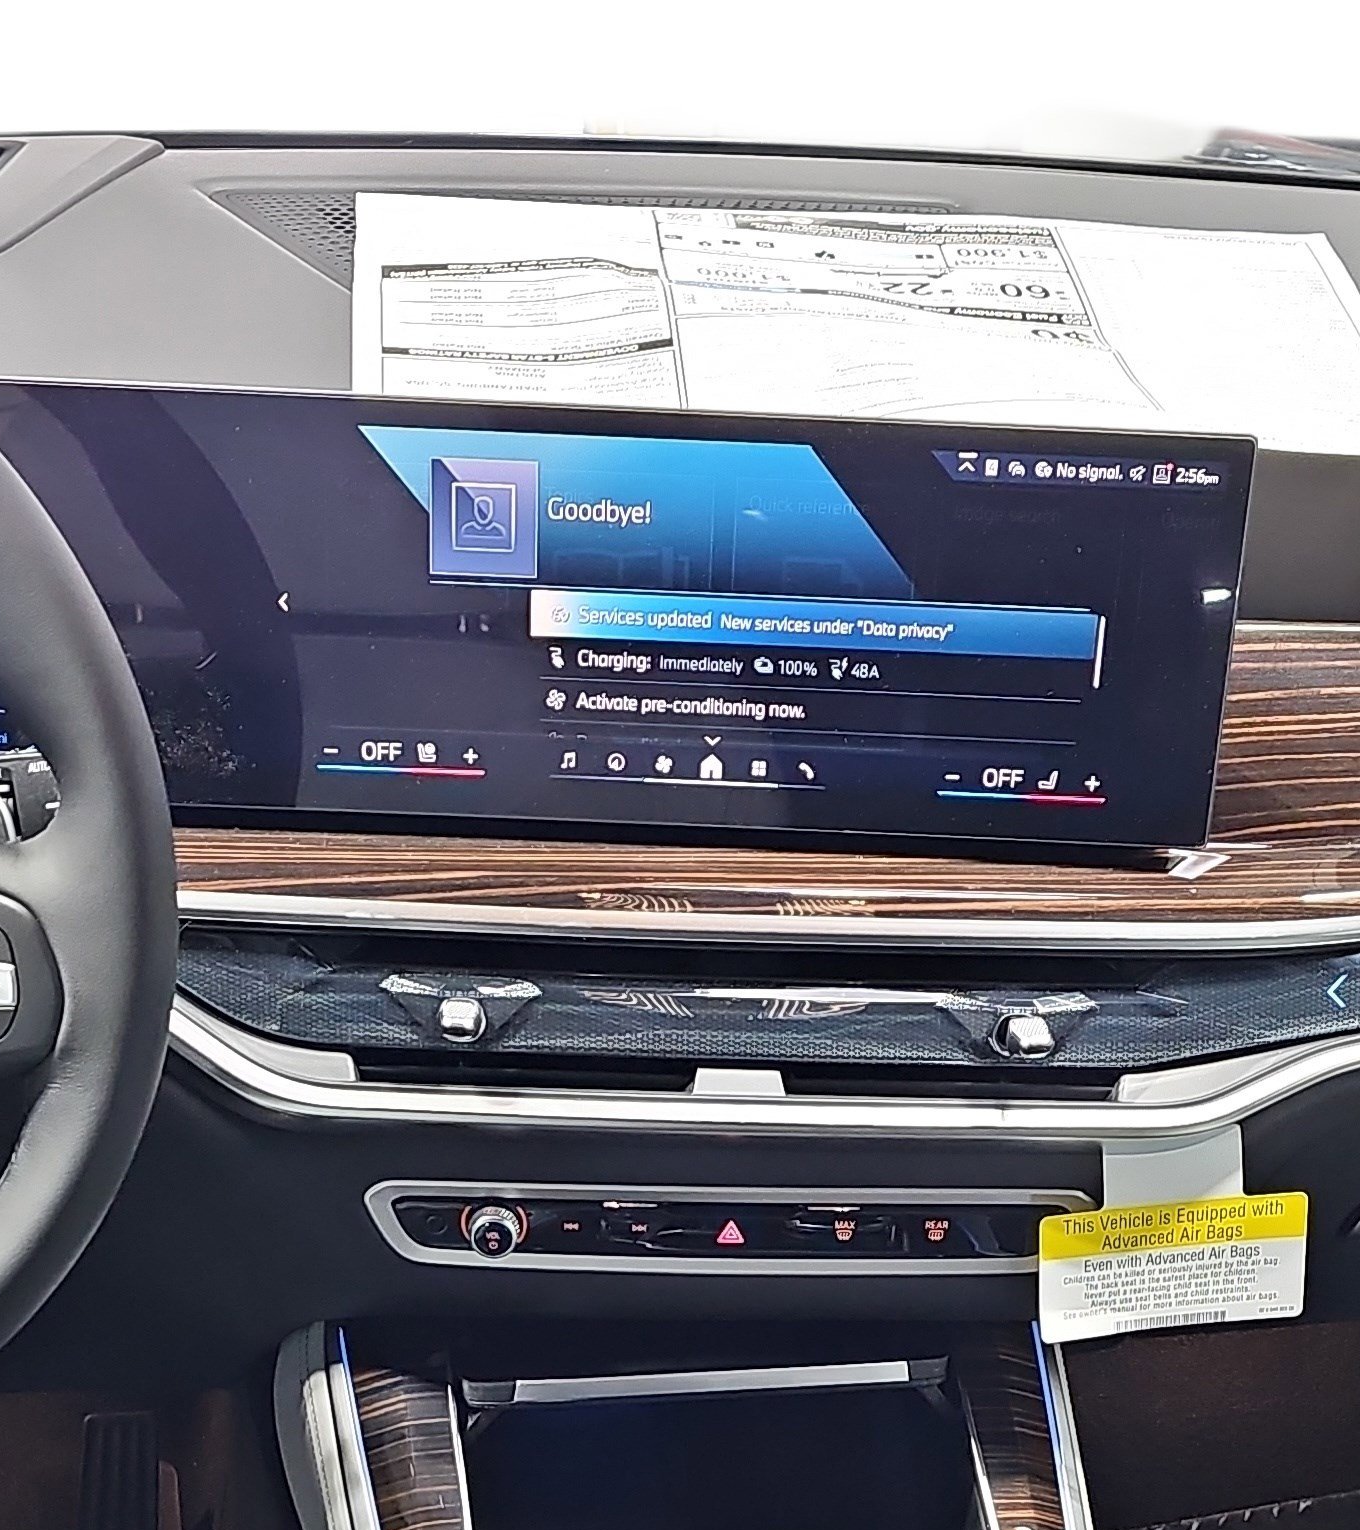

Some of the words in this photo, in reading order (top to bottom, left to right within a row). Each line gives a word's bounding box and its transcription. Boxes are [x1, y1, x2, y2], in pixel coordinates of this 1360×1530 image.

[1000, 283, 1050, 300] 60
[1057, 462, 1076, 478] No
[1175, 467, 1220, 486] 2:56pm
[547, 497, 652, 527] Goodbye!
[578, 605, 644, 626] Services
[648, 611, 712, 633] updated
[720, 614, 752, 630] New
[754, 616, 811, 634] services
[813, 618, 855, 635] under
[577, 648, 652, 673] Charging:
[659, 653, 744, 675] Immediately
[777, 660, 818, 677] 100%
[850, 662, 881, 680] 48A
[576, 691, 638, 712] Activate
[641, 695, 766, 721] pre-conditioning
[769, 703, 806, 719] now.
[361, 741, 403, 762] OFF
[982, 768, 1025, 789] OFF
[834, 1220, 856, 1230] MAX
[925, 1220, 949, 1230] REAR
[1062, 1217, 1095, 1236] This
[1099, 1211, 1154, 1232] Vehicle
[1158, 1209, 1171, 1226] is
[1176, 1202, 1247, 1225] Equipped
[1251, 1199, 1284, 1217] with
[1101, 1227, 1175, 1251] Advanced
[1179, 1226, 1201, 1243] Air
[1206, 1224, 1243, 1241] Bags
[1084, 1259, 1113, 1273] Even
[1116, 1254, 1142, 1270] with
[1145, 1247, 1205, 1267] Advanced
[1208, 1246, 1227, 1260] Air
[1230, 1245, 1261, 1260] Bags
[1063, 1275, 1096, 1286] Children
[1097, 1272, 1111, 1281] can
[1113, 1271, 1123, 1280] be
[1124, 1268, 1146, 1278] killed
[1147, 1267, 1156, 1275] or
[1158, 1263, 1194, 1276] seriously
[1195, 1260, 1223, 1272] injured
[1224, 1259, 1235, 1270] by
[1236, 1258, 1249, 1267] the
[1250, 1257, 1261, 1267] air
[1085, 1283, 1099, 1291] The
[1101, 1280, 1119, 1290] back
[1148, 1275, 1161, 1284] the
[1188, 1270, 1208, 1282] place
[1210, 1269, 1221, 1279] for
[1084, 1291, 1106, 1300] Never
[1108, 1288, 1121, 1299] put
[1173, 1280, 1192, 1291] child
[1222, 1276, 1235, 1286] the
[1090, 1297, 1117, 1309] Always
[1174, 1289, 1188, 1299] and
[1190, 1287, 1210, 1298] child
[1063, 1311, 1077, 1321] See
[1140, 1302, 1151, 1311] for
[1153, 1301, 1173, 1310] more
[1175, 1295, 1220, 1307] information
[1221, 1293, 1244, 1303] about
[1245, 1292, 1256, 1302] air
